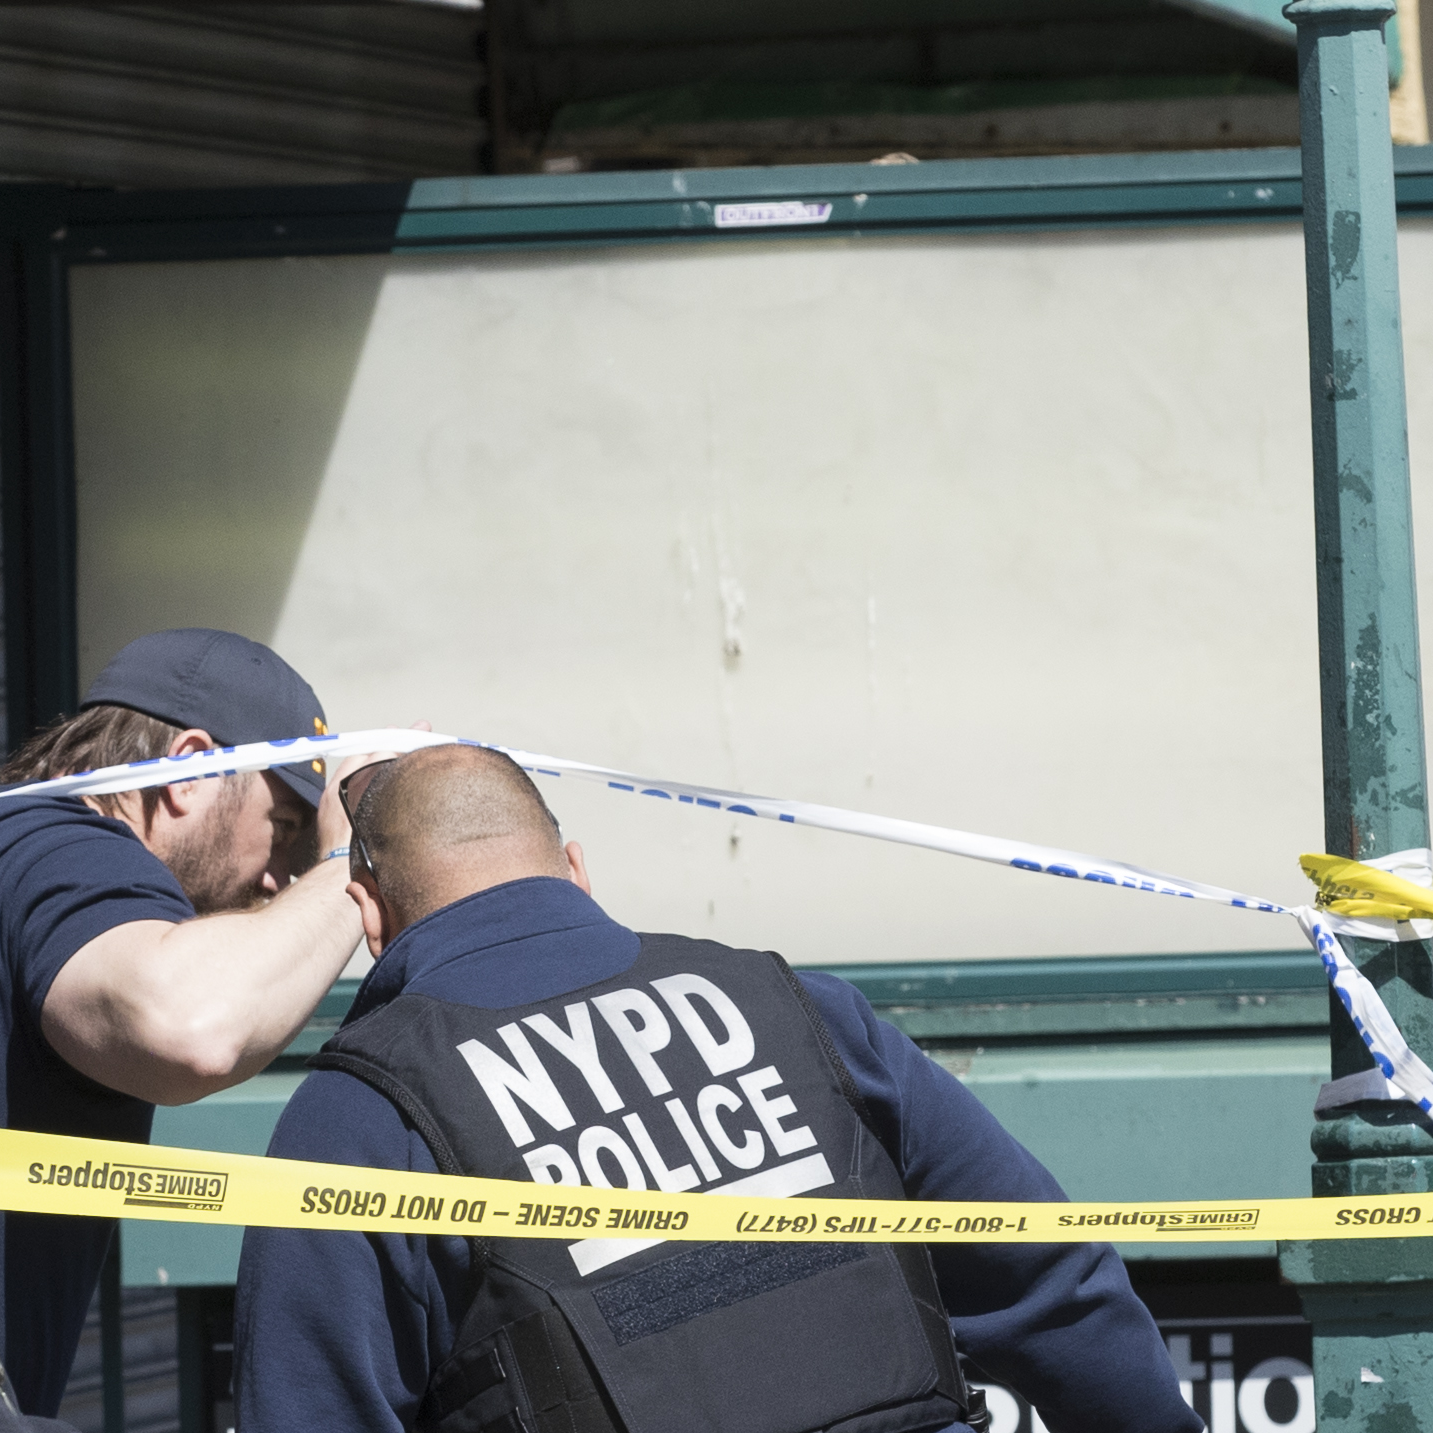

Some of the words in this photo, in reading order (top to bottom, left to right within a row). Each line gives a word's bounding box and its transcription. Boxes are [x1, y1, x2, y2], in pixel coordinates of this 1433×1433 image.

[456, 973, 756, 1148] NYPD
[522, 1065, 818, 1194] POLICE
[28, 1162, 223, 1199] CRIMEstoppers
[300, 1186, 387, 1219] CROSS
[391, 1193, 443, 1220] NOT
[450, 1199, 487, 1223] DO
[515, 1203, 600, 1228] SCENE
[606, 1208, 689, 1231] CRIME
[736, 1211, 818, 1234] (8477)
[824, 1214, 1029, 1234] 1-800-577-TIPS
[1058, 1212, 1253, 1231] CRIMEstoppers
[1335, 1206, 1421, 1226] CROSS
